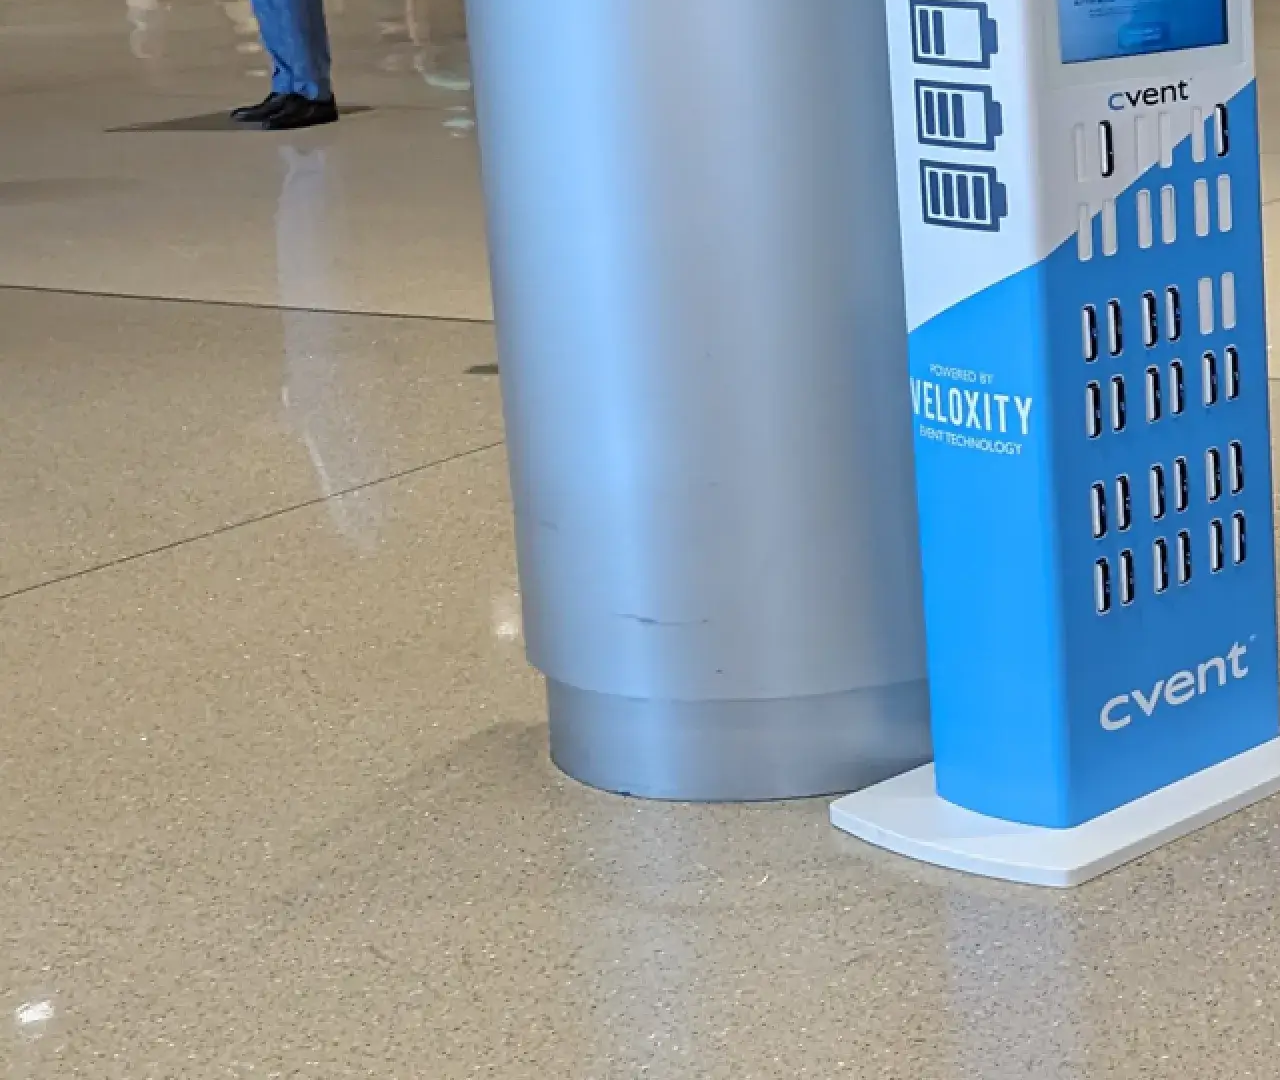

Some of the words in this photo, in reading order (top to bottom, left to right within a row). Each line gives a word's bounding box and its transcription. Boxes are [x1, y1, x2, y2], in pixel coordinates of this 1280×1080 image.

[1108, 79, 1189, 110] cvent
[929, 363, 976, 383] POWERED
[980, 372, 995, 384] BY
[909, 376, 1033, 435] VELOXITY
[919, 424, 945, 441] EVENT
[945, 431, 1023, 455] TECHNOLOGY
[1100, 641, 1249, 731] cvent
